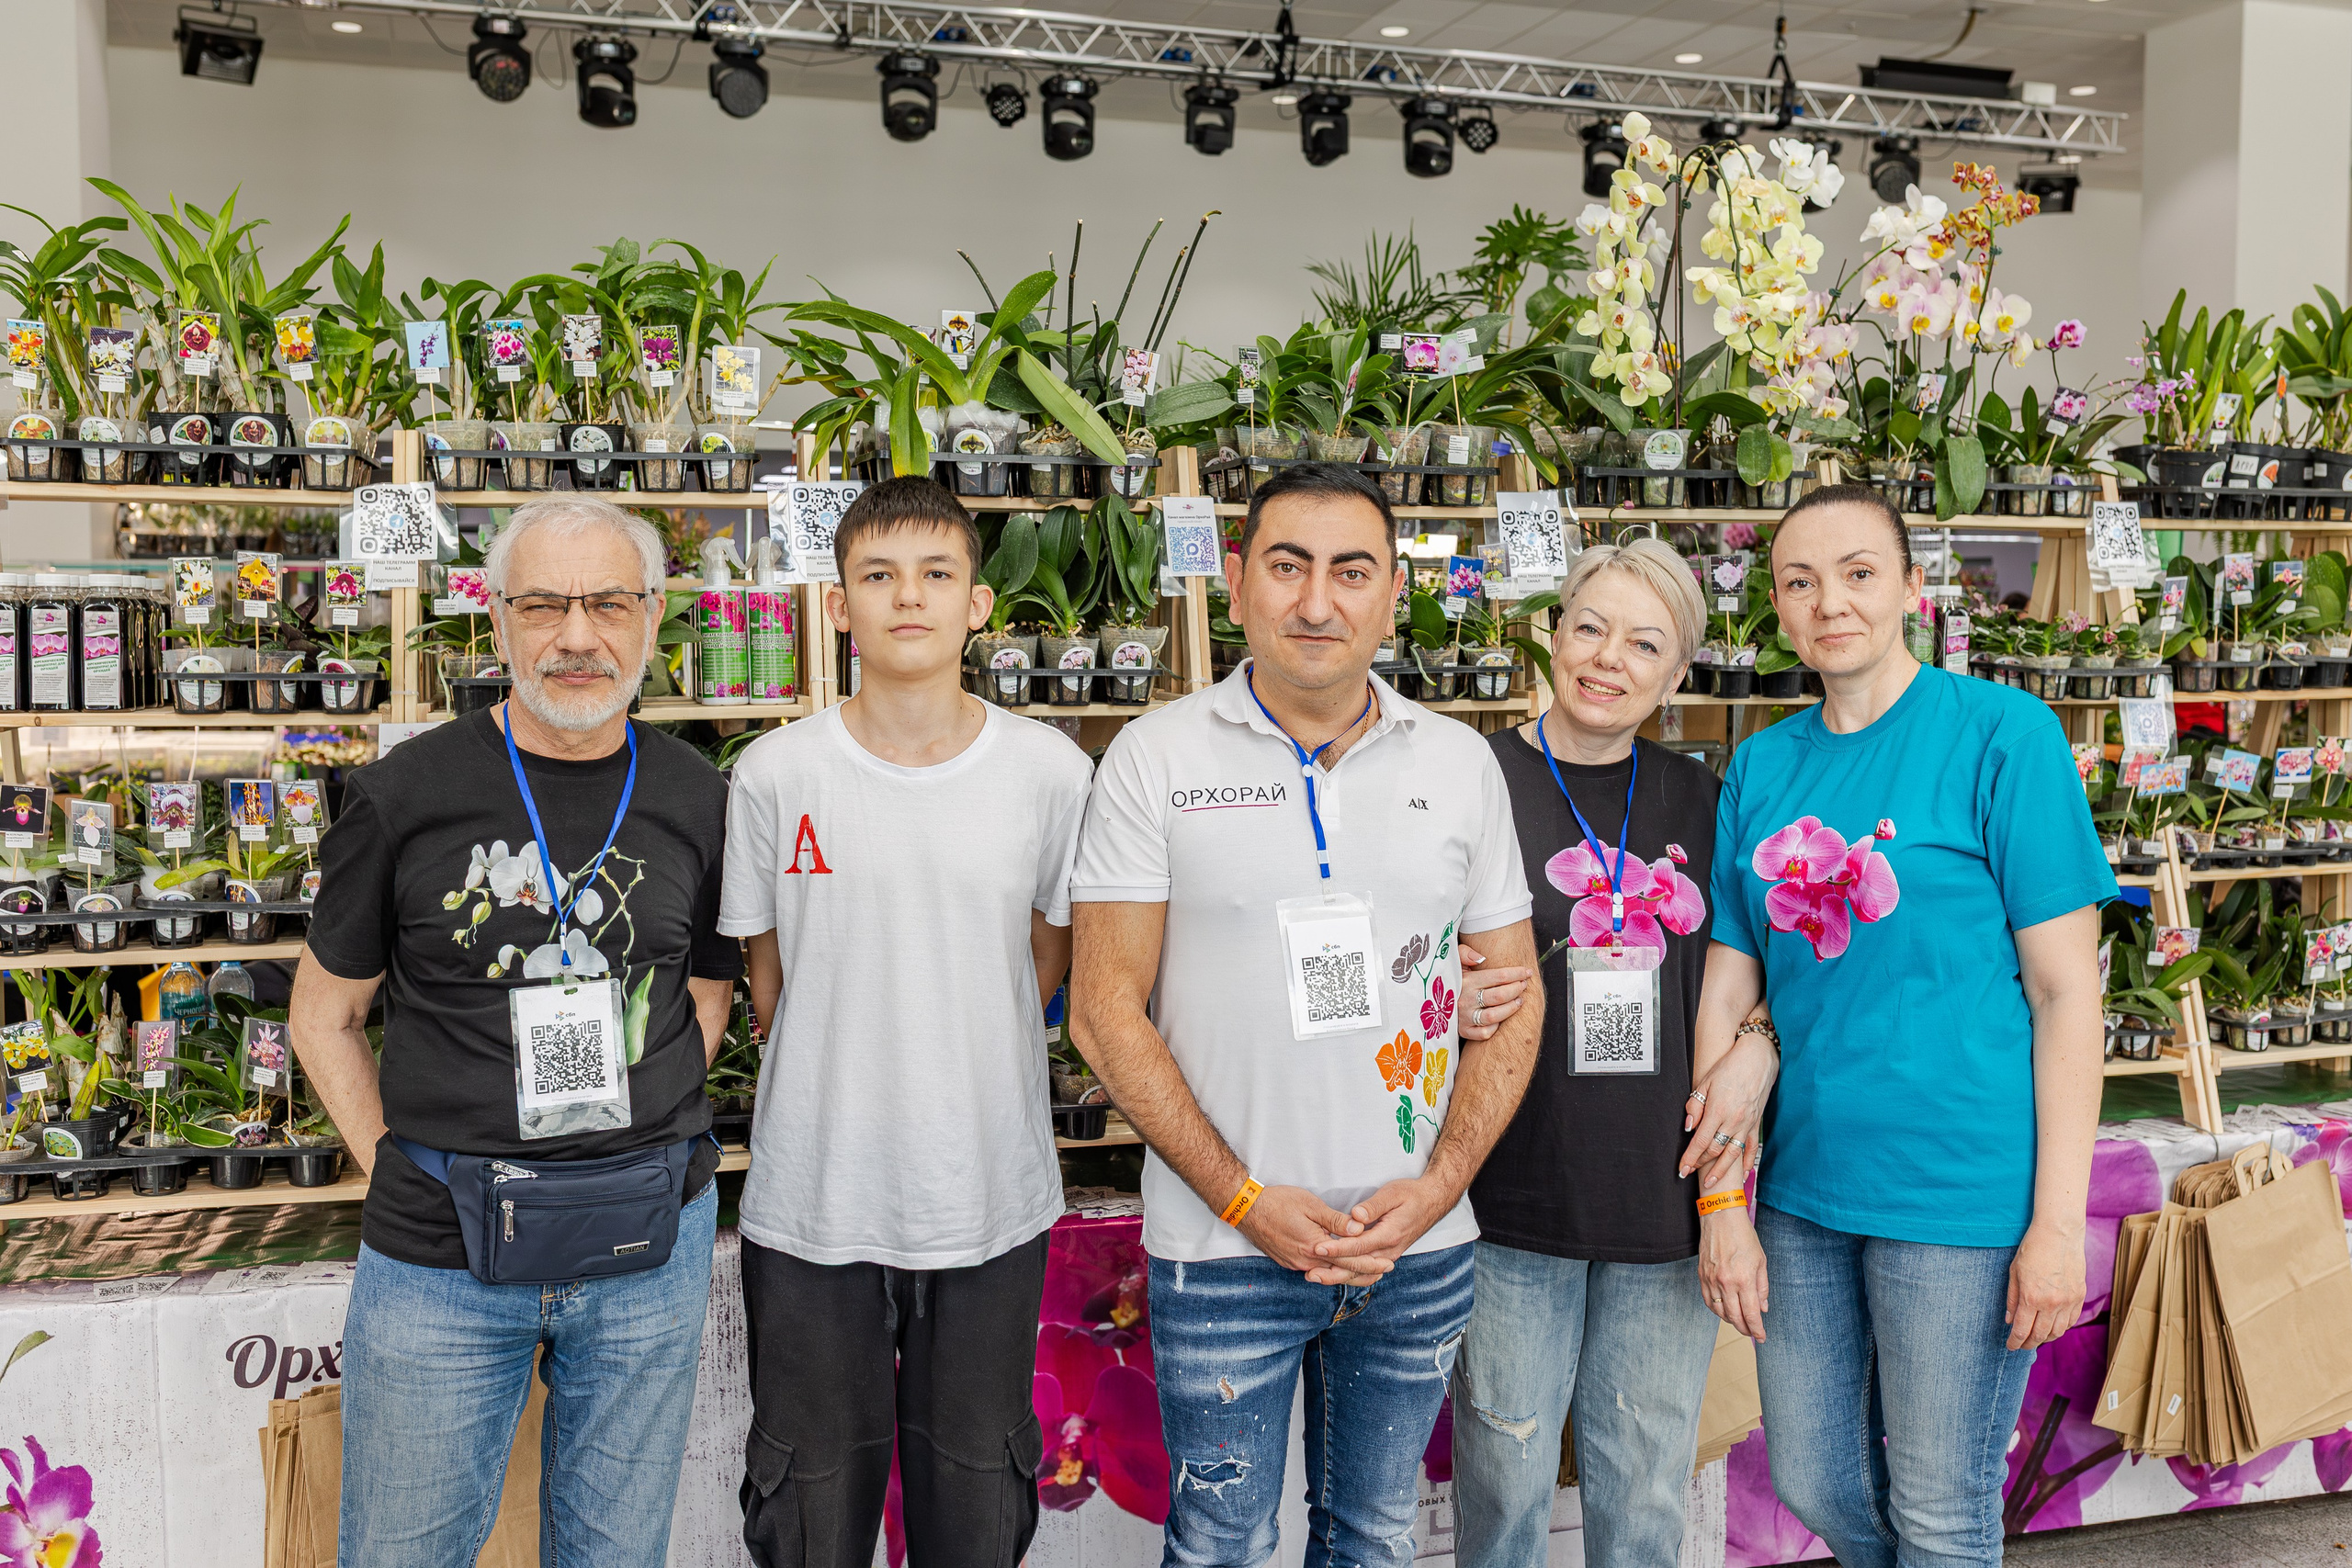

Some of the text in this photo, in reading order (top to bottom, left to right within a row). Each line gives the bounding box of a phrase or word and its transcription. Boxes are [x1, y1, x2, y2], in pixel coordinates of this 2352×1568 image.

[1171, 783, 1286, 807] ОРХОРАЙ
[174, 1004, 206, 1016] ЧЕРНОГО
[1706, 1194, 1745, 1208] Orchidium
[225, 1334, 343, 1400] Орх
[1418, 1495, 1446, 1507] овых
